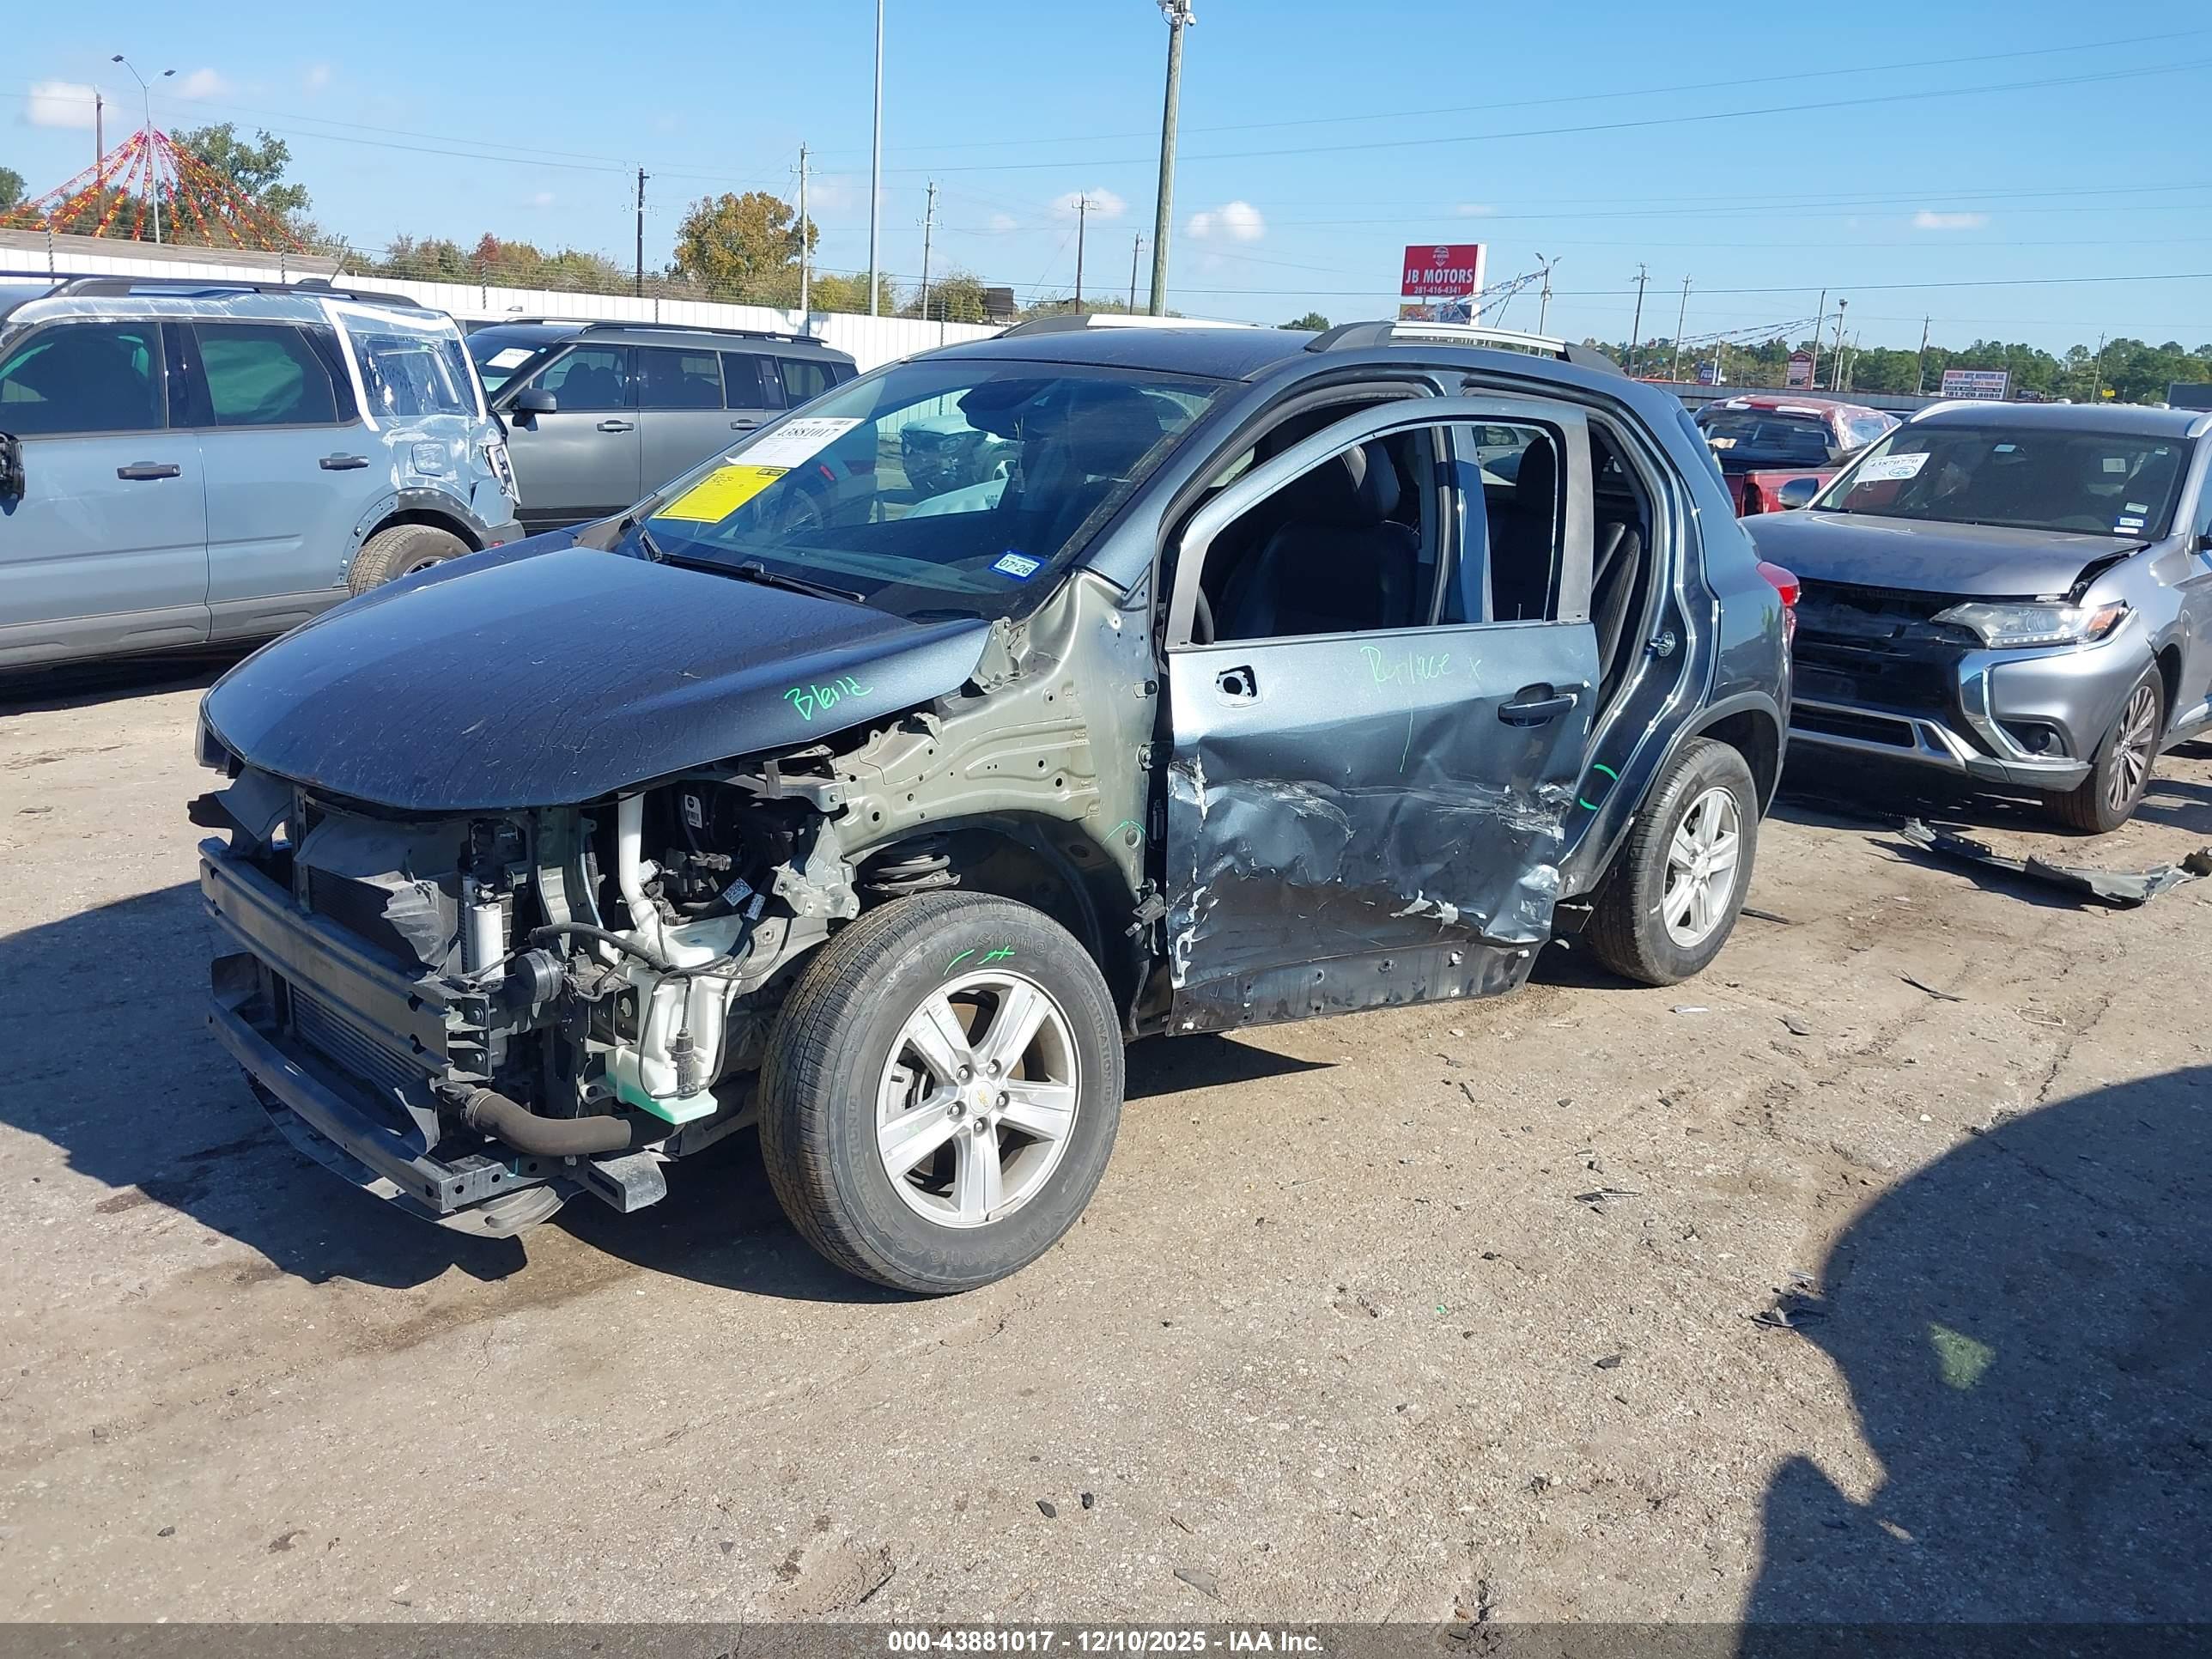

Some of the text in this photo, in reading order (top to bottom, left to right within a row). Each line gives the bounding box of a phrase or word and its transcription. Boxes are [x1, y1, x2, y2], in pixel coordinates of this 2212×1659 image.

[1406, 268, 1473, 284] JB MOTORS
[1413, 286, 1461, 295] 281-416-4341
[921, 932, 1047, 975] Firestone
